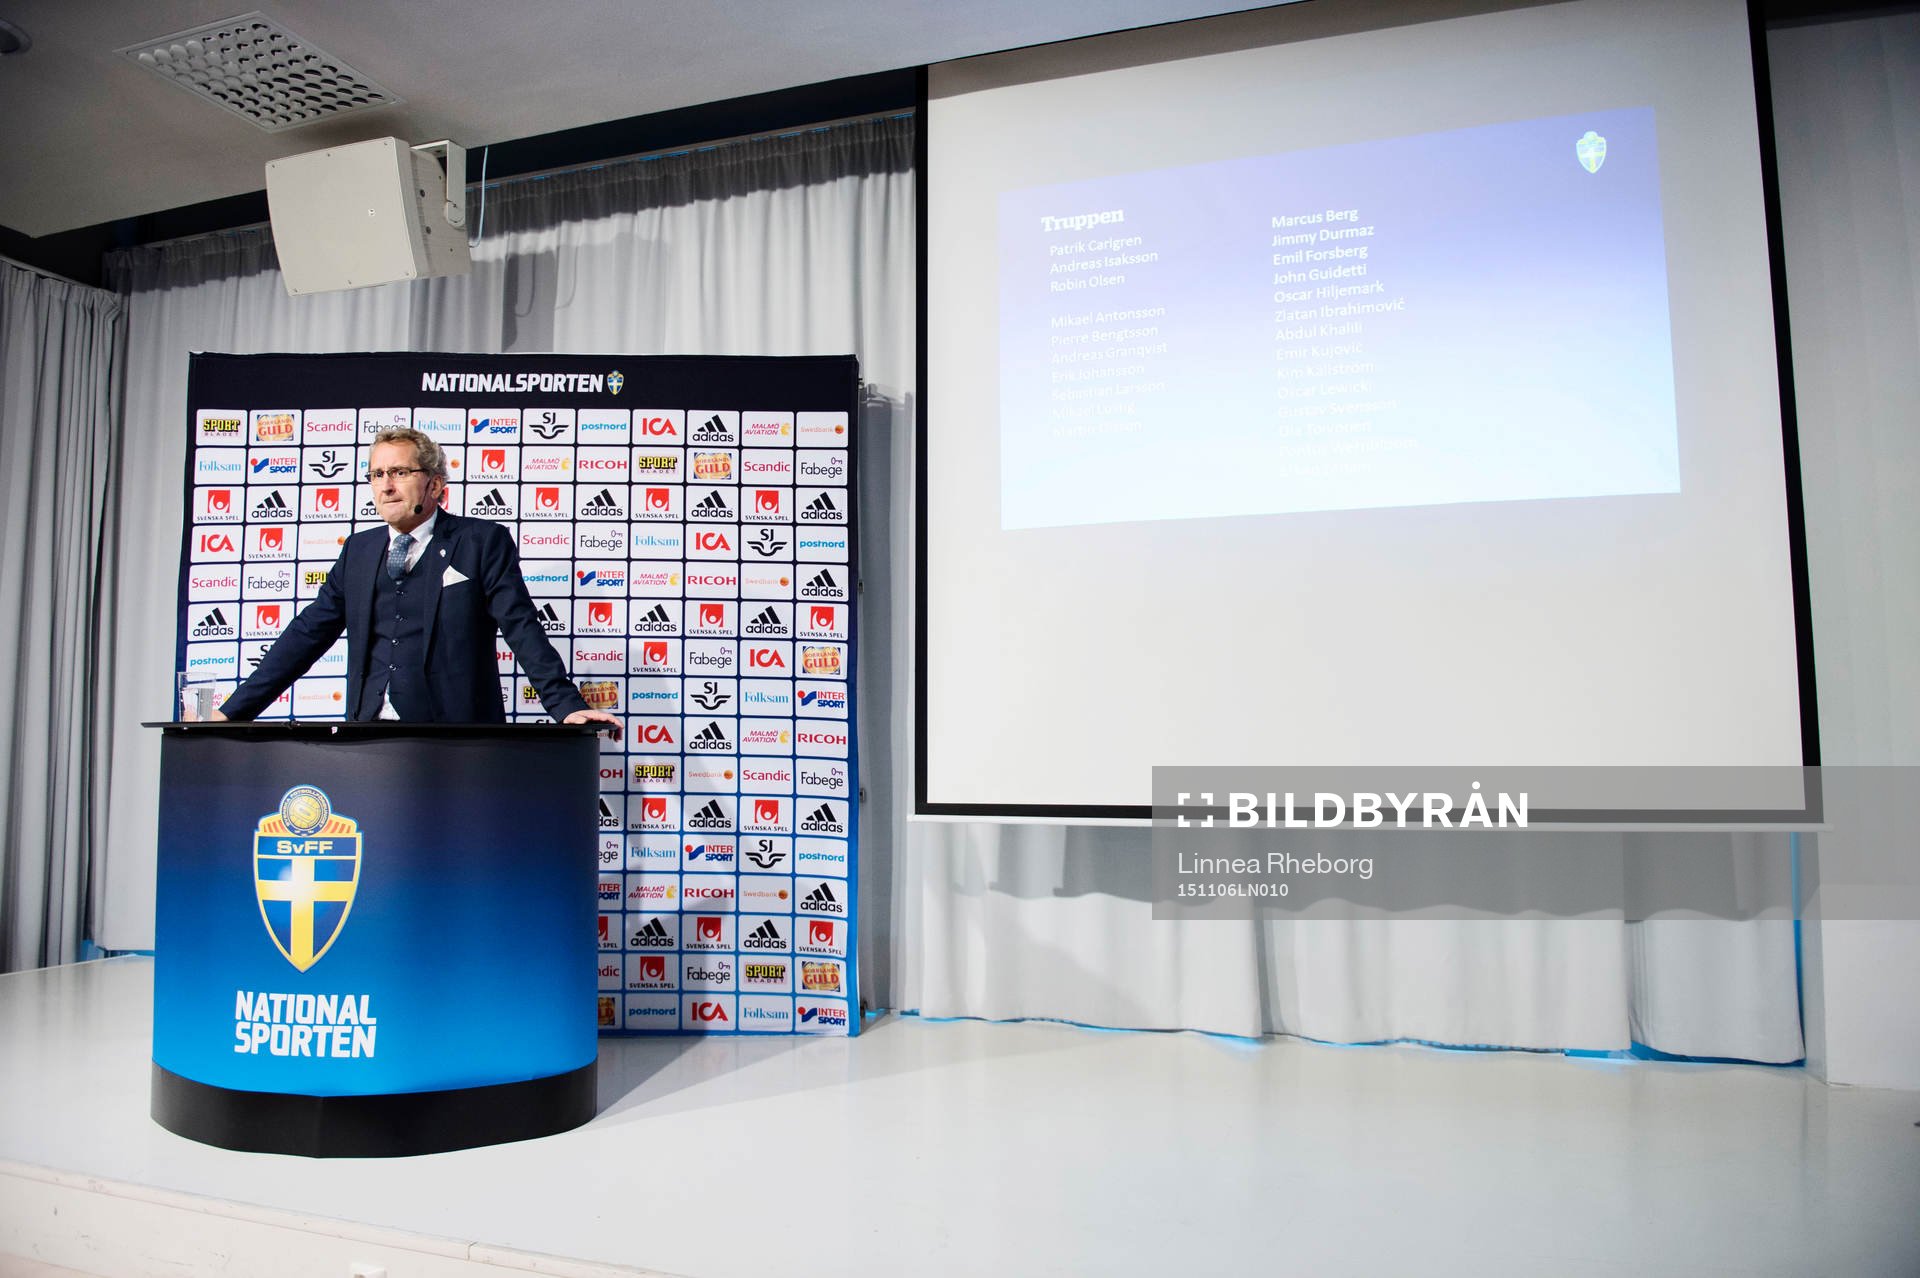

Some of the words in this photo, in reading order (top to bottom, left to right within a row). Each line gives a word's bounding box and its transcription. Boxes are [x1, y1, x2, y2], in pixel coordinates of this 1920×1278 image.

[1041, 209, 1125, 232] Truppen
[1272, 214, 1322, 228] Marcus
[1326, 209, 1359, 222] Berg
[1272, 232, 1316, 247] Jimmy
[1319, 225, 1374, 242] Durmaz
[1050, 241, 1085, 256] Patrik
[1088, 235, 1142, 251] Carlgren
[1273, 250, 1302, 266] Emil
[1306, 245, 1368, 262] Forsberg
[1050, 259, 1101, 274] Andreas
[1105, 251, 1159, 267] Isaksson
[1273, 271, 1306, 285] John
[1309, 264, 1367, 280] Guidetti
[1050, 277, 1086, 292] Robin
[1089, 274, 1125, 288] Olsen
[1274, 289, 1312, 303] Oscar
[1316, 280, 1385, 300] Hiljemark
[1051, 312, 1093, 328] Mikael
[1095, 306, 1166, 323] Antonsson
[1274, 309, 1317, 323] Zlatan
[1275, 326, 1317, 341] Abdul
[421, 372, 604, 393] NATIONALSPORTEN
[490, 418, 517, 426] INTER
[542, 412, 556, 424] SJ
[203, 419, 240, 432] SPORT
[258, 424, 293, 435] GULD
[307, 421, 353, 431] Scandic
[490, 424, 517, 433] SPORT
[581, 422, 627, 431] postnord
[642, 418, 677, 435] ICA
[693, 432, 734, 442] adidas
[270, 457, 297, 466] INTER
[322, 451, 335, 463] SJ
[270, 464, 297, 473] SPORT
[579, 460, 627, 469] RICOH
[639, 456, 677, 470] SPORT
[696, 462, 730, 474] GULD
[744, 462, 791, 472] Scandic
[801, 463, 843, 478] Fabege
[252, 507, 293, 518] adidas
[471, 505, 512, 515] adidas
[692, 507, 733, 518] adidas
[801, 509, 843, 520] adidas
[523, 534, 570, 545] Scandic
[635, 535, 679, 546] Folksam
[760, 529, 774, 541] SJ
[201, 534, 234, 552] ICA
[581, 535, 623, 551] Fabege
[696, 533, 730, 550] ICA
[800, 539, 845, 549] postnord
[598, 570, 624, 579] INTER
[192, 577, 238, 588] Scandic
[248, 575, 290, 591] Fabege
[598, 578, 624, 587] SPORT
[688, 575, 736, 586] RICOH
[801, 586, 843, 597] adidas
[193, 625, 234, 636] adidas
[635, 622, 677, 632] adidas
[746, 624, 788, 634] adidas
[576, 650, 623, 661] Scandic
[690, 652, 732, 668] Fabege
[750, 649, 785, 667] ICA
[190, 656, 235, 667] postnord
[804, 658, 839, 668] GULD
[704, 682, 718, 693] SJ
[632, 690, 678, 700] postnord
[745, 692, 788, 703] Folksam
[818, 691, 845, 700] INTER
[818, 699, 845, 708] SPORT
[638, 725, 674, 743] ICA
[798, 734, 846, 744] RICOH
[689, 740, 731, 750] adidas
[635, 765, 675, 778] SPORT
[743, 770, 791, 781] Scandic
[801, 772, 844, 789] Fabege
[689, 818, 732, 828] adidas
[801, 822, 843, 833] adidas
[277, 840, 333, 854] SvFF
[706, 845, 733, 853] INTER
[759, 840, 772, 852] SJ
[631, 847, 676, 858] Folksam
[706, 853, 733, 862] SPORT
[799, 852, 844, 862] postnord
[684, 888, 734, 898] RICOH
[800, 902, 842, 912] adidas
[631, 937, 674, 947] adidas
[744, 939, 786, 949] adidas
[688, 967, 730, 984] Fabege
[746, 966, 784, 978] SPORT
[804, 974, 839, 984] GULD
[235, 990, 377, 1025] NATIONAL
[629, 1007, 676, 1016] postnord
[692, 1002, 728, 1021] ICA
[818, 1008, 846, 1017] INTER
[744, 1008, 788, 1020] Folksam
[818, 1017, 846, 1026] SPORT
[234, 1021, 377, 1058] SPORTEN
